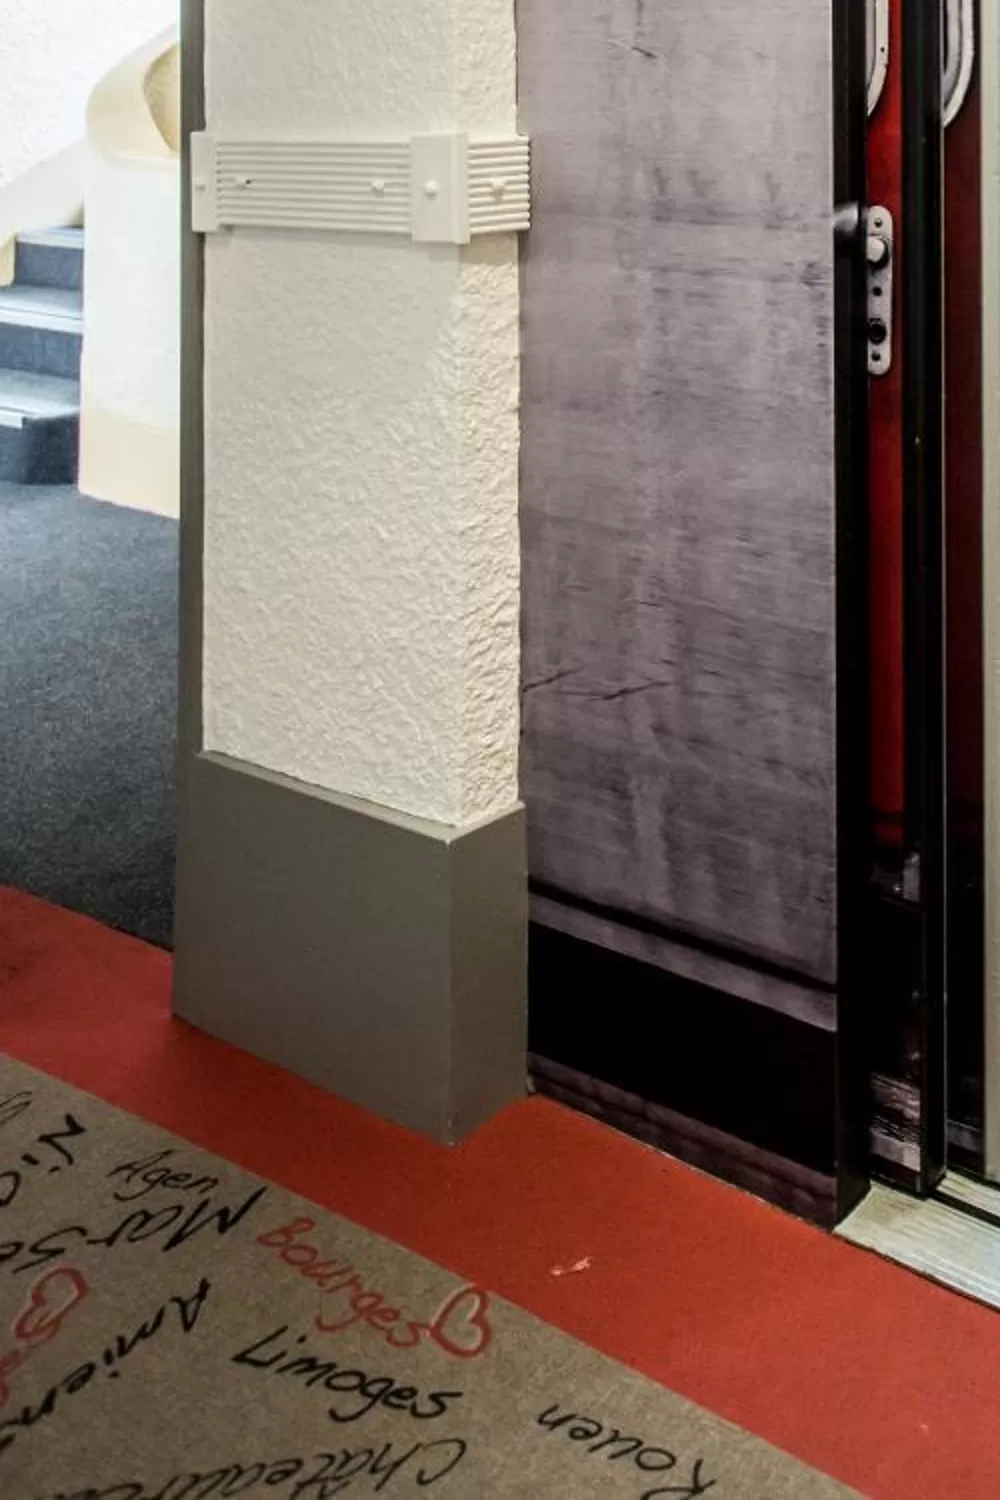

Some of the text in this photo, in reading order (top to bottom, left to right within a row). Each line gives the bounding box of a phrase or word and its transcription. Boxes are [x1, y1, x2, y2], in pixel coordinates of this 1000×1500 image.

[106, 1149, 219, 1201] Agen
[257, 1217, 432, 1348] Bourges
[231, 1325, 464, 1423] Limoges
[538, 1404, 717, 1500] Rouen
